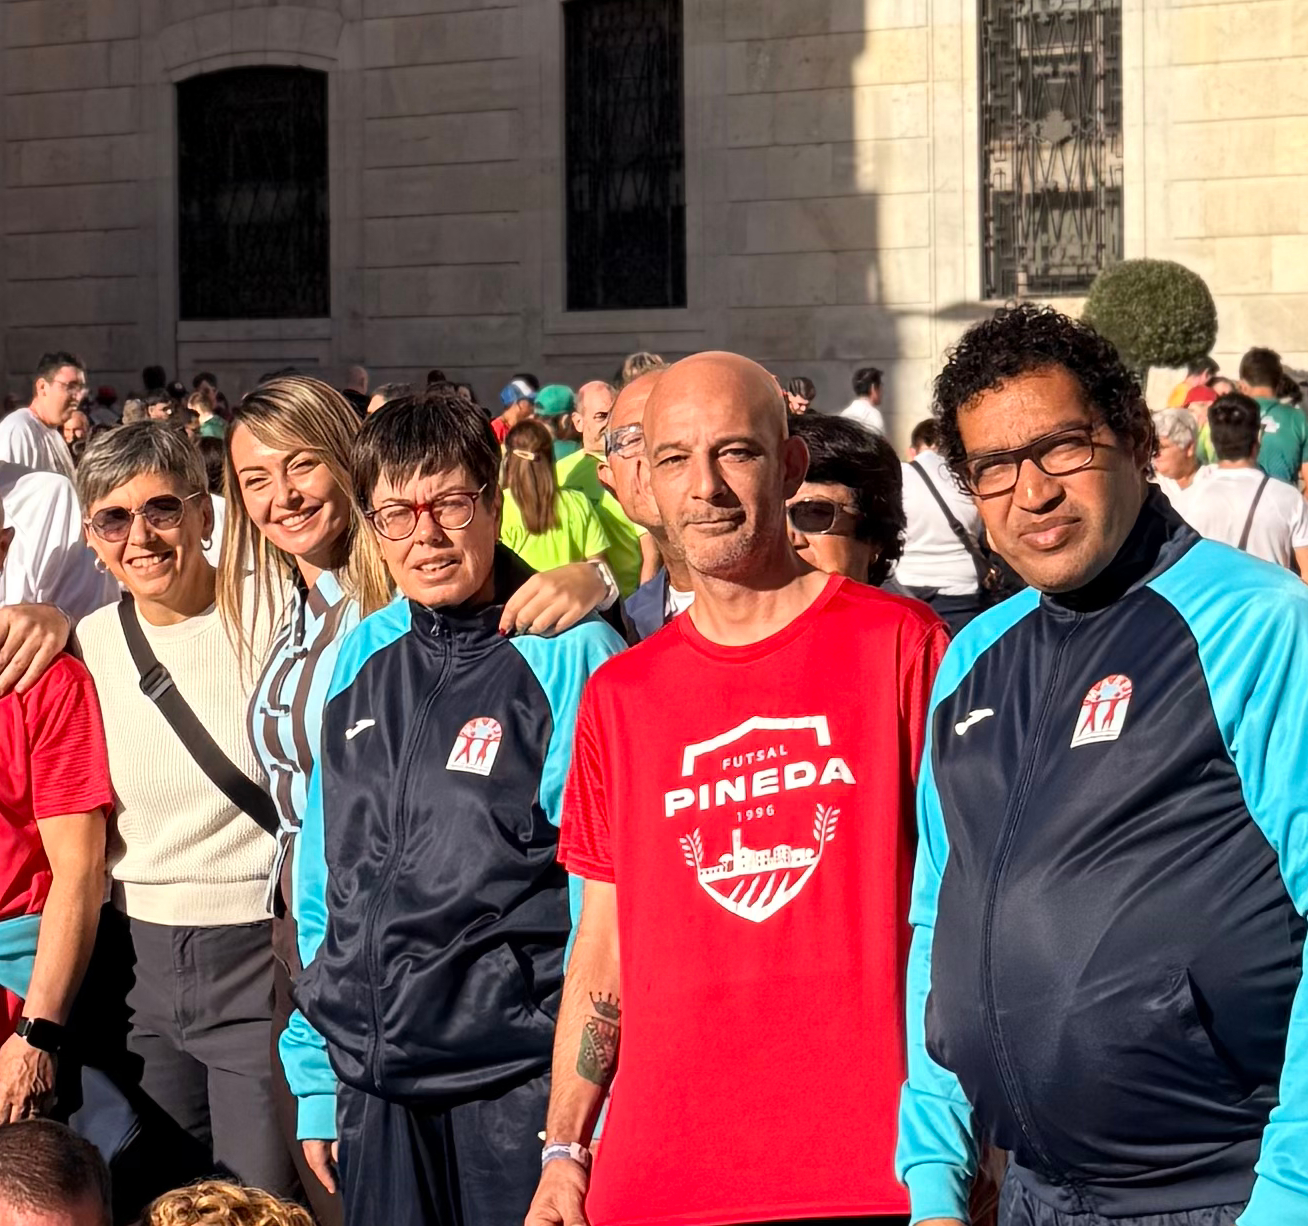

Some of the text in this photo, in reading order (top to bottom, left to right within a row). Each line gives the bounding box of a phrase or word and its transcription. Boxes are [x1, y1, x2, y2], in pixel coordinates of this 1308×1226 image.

[722, 744, 789, 771] FUTSAL
[664, 757, 857, 819] PINEDA
[737, 804, 776, 823] 1996
